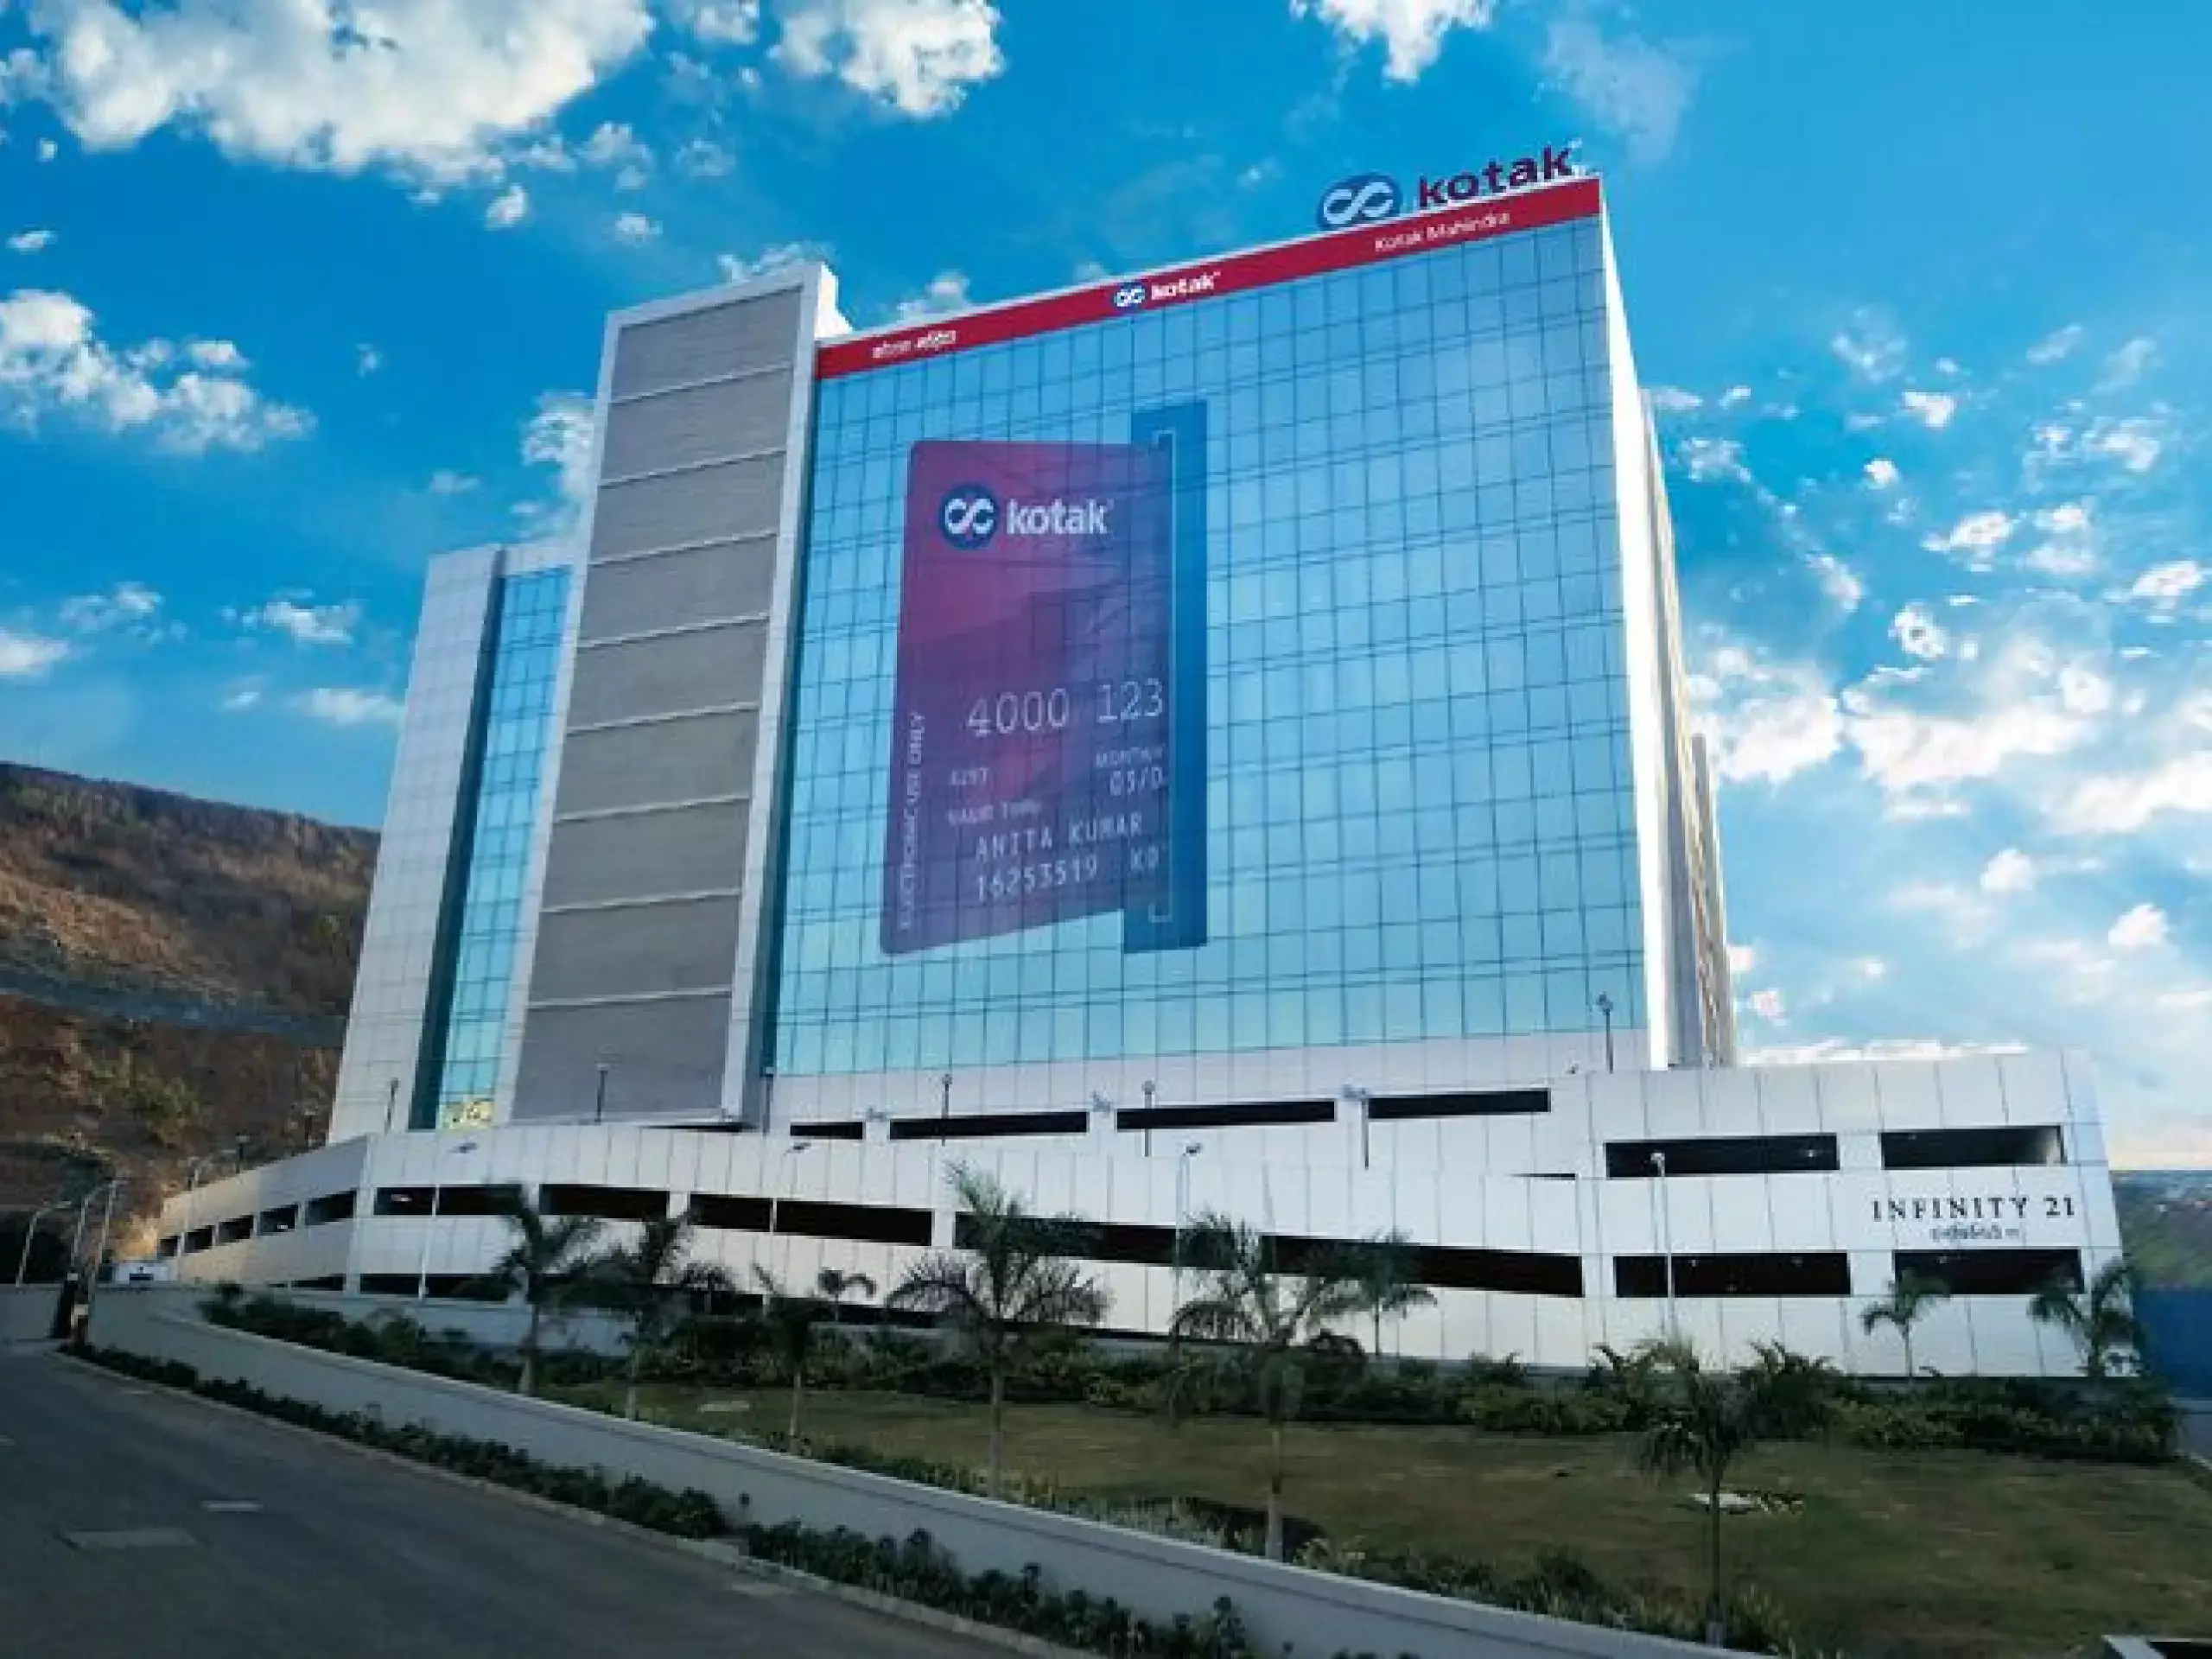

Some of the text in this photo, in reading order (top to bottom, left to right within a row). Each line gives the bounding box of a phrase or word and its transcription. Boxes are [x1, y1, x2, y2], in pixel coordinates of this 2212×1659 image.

[1417, 143, 1576, 207] kotak
[1151, 274, 1217, 301] kotak
[1006, 498, 1108, 535] kotak
[966, 677, 1163, 737] 4000 123
[1068, 810, 1142, 843] KUMAR
[1873, 1194, 2075, 1222] INFINITY 21
